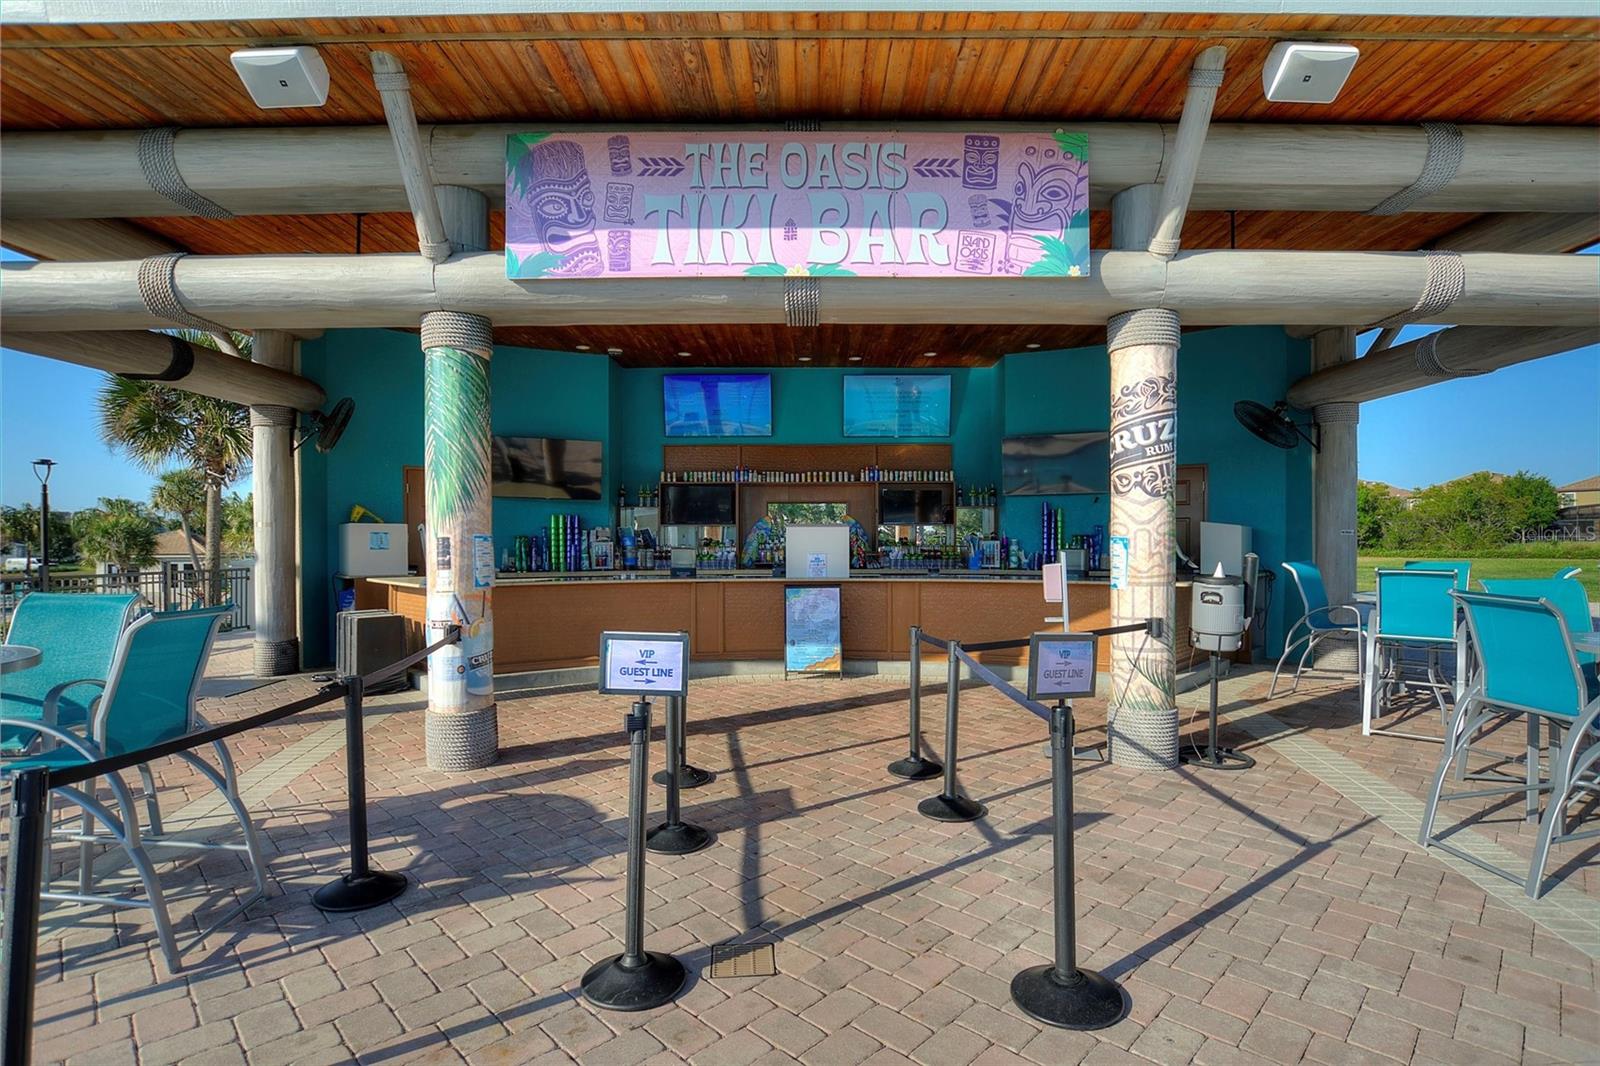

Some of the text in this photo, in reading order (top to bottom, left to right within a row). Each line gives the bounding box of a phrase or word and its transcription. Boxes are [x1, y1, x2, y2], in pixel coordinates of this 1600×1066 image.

[685, 142, 909, 190] THE OASIS
[643, 192, 951, 266] TIKI BAR
[962, 235, 991, 249] ISLAND
[960, 246, 989, 260] OASIS
[1145, 442, 1173, 457] RUM
[639, 649, 655, 658] VIP
[1059, 650, 1071, 659] VIP
[619, 667, 673, 677] GUEST LINE
[1043, 669, 1084, 679] GUEST LINE
